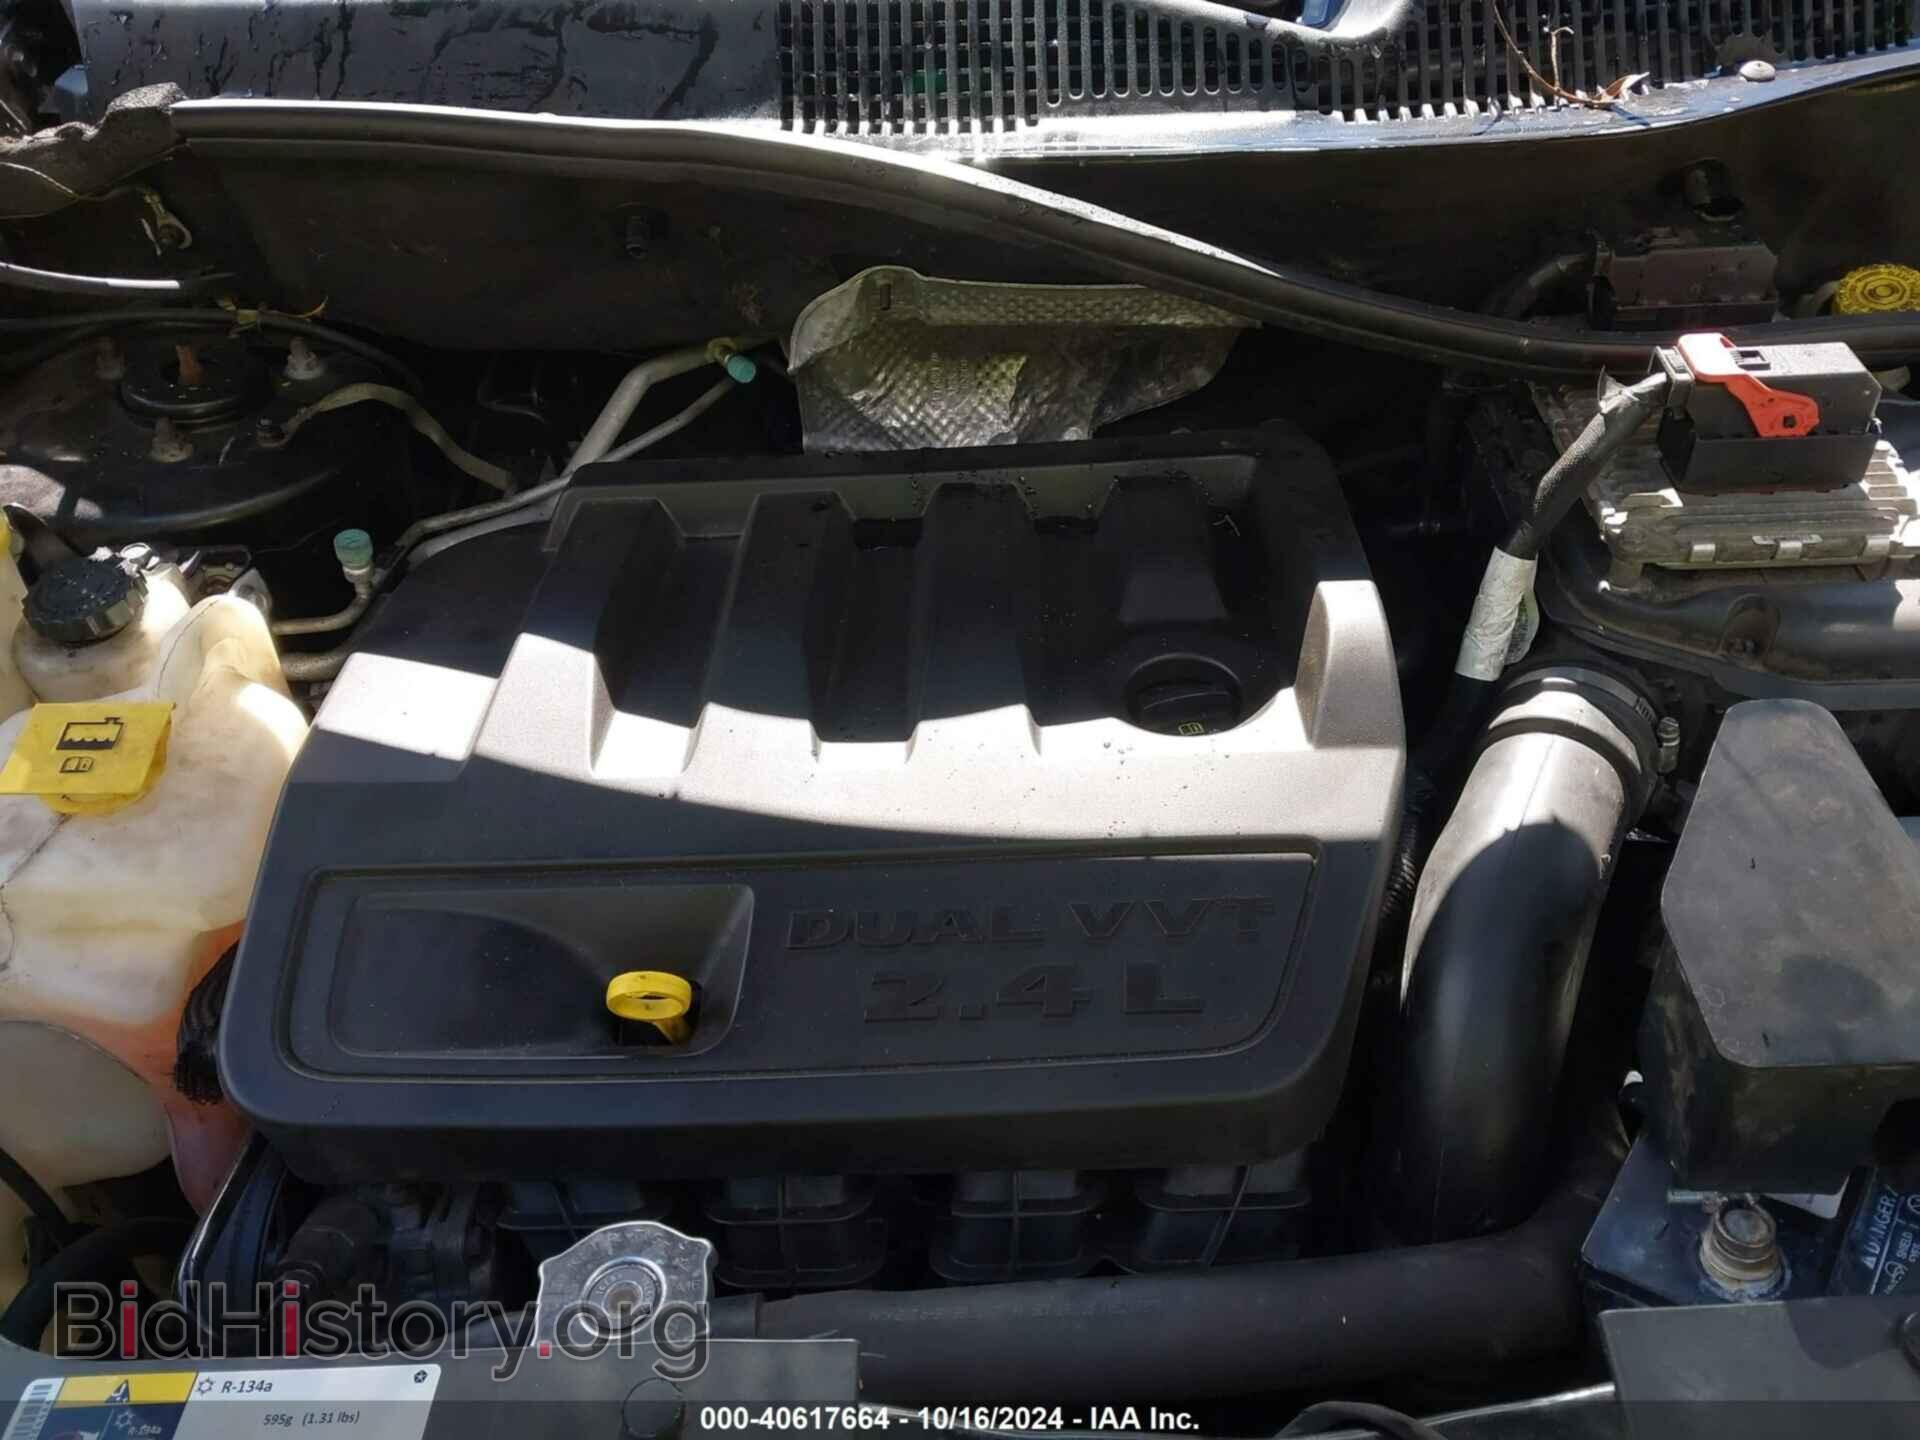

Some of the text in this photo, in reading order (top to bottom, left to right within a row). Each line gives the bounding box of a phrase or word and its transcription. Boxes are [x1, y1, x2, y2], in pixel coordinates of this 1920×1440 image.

[784, 896, 1278, 951] DUAL VVT
[220, 1379, 274, 1394] R-134a
[263, 1410, 360, 1427] 595g (1.31 lbs)
